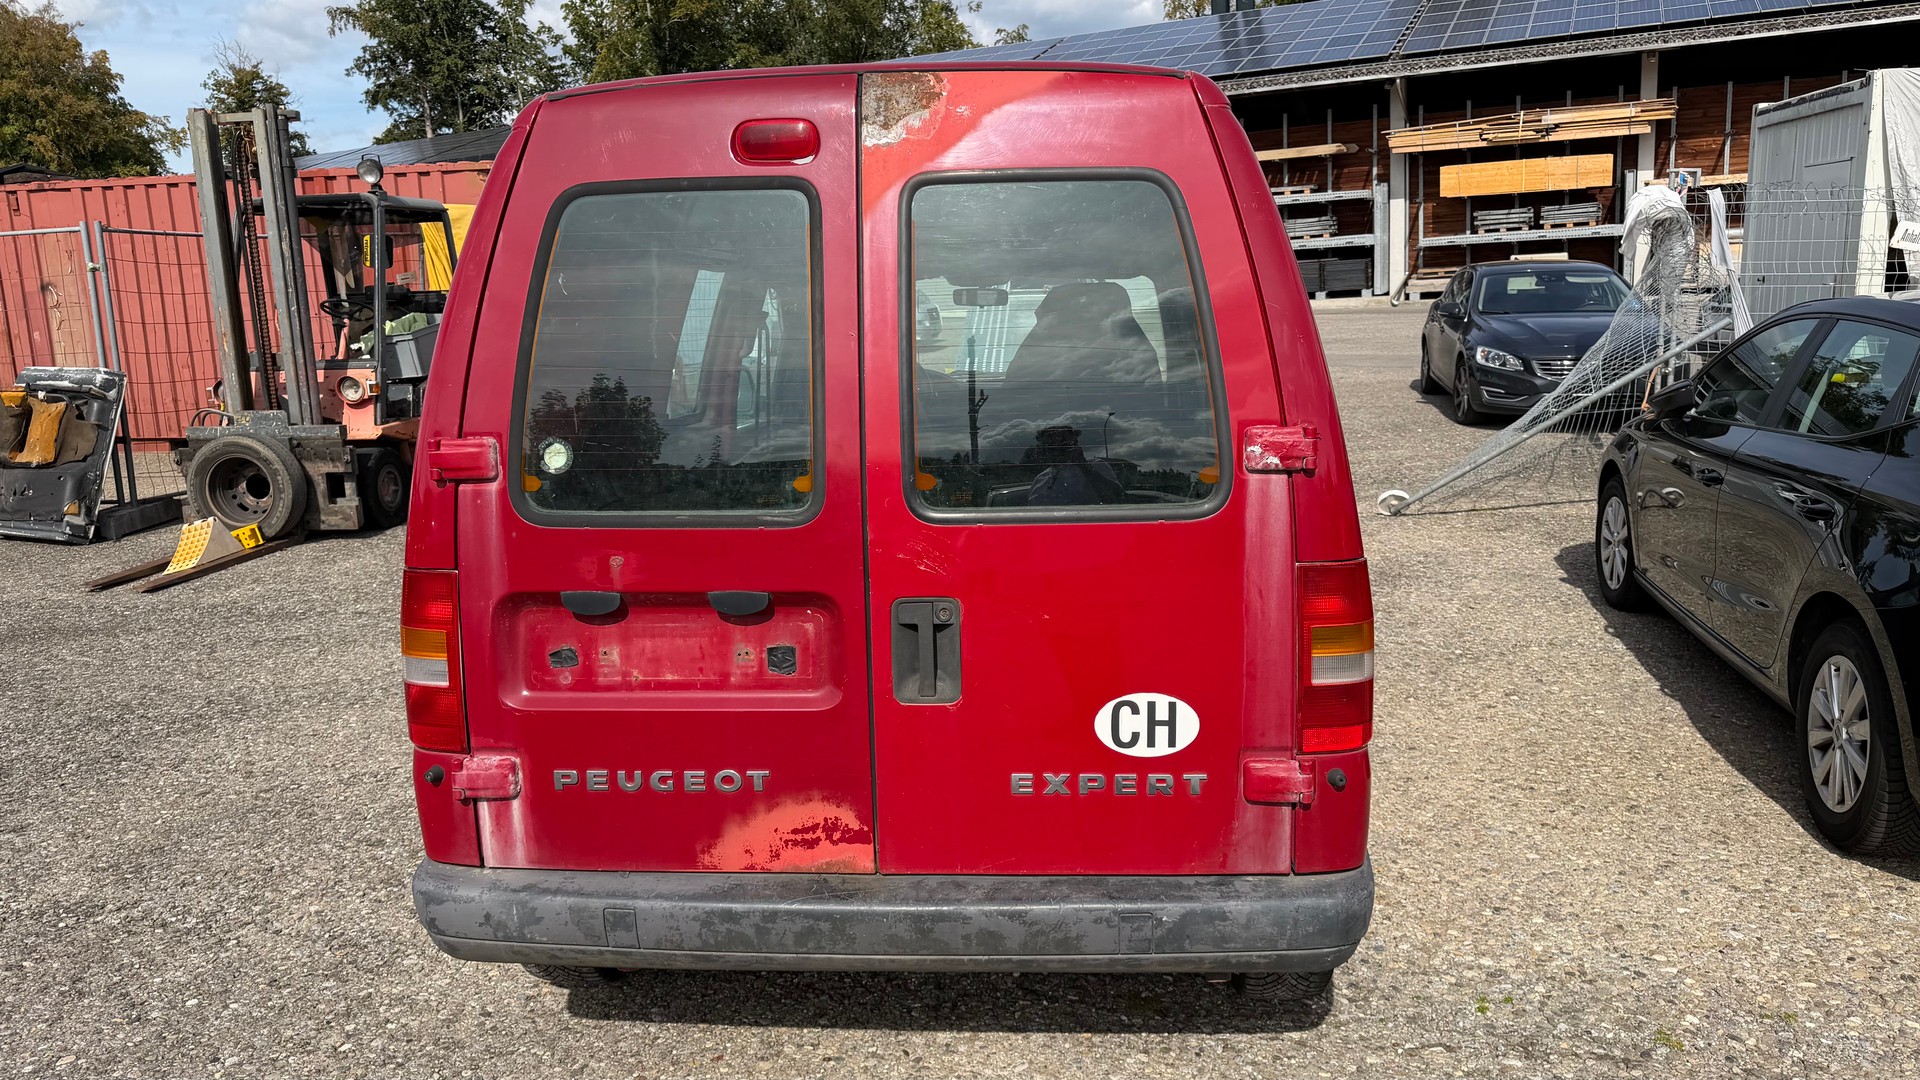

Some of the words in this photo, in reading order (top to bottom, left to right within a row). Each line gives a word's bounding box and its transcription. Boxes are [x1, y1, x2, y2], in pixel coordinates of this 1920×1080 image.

[1110, 700, 1177, 749] CH
[553, 769, 770, 792] PEUGEOT
[1011, 773, 1208, 795] EXPERT
